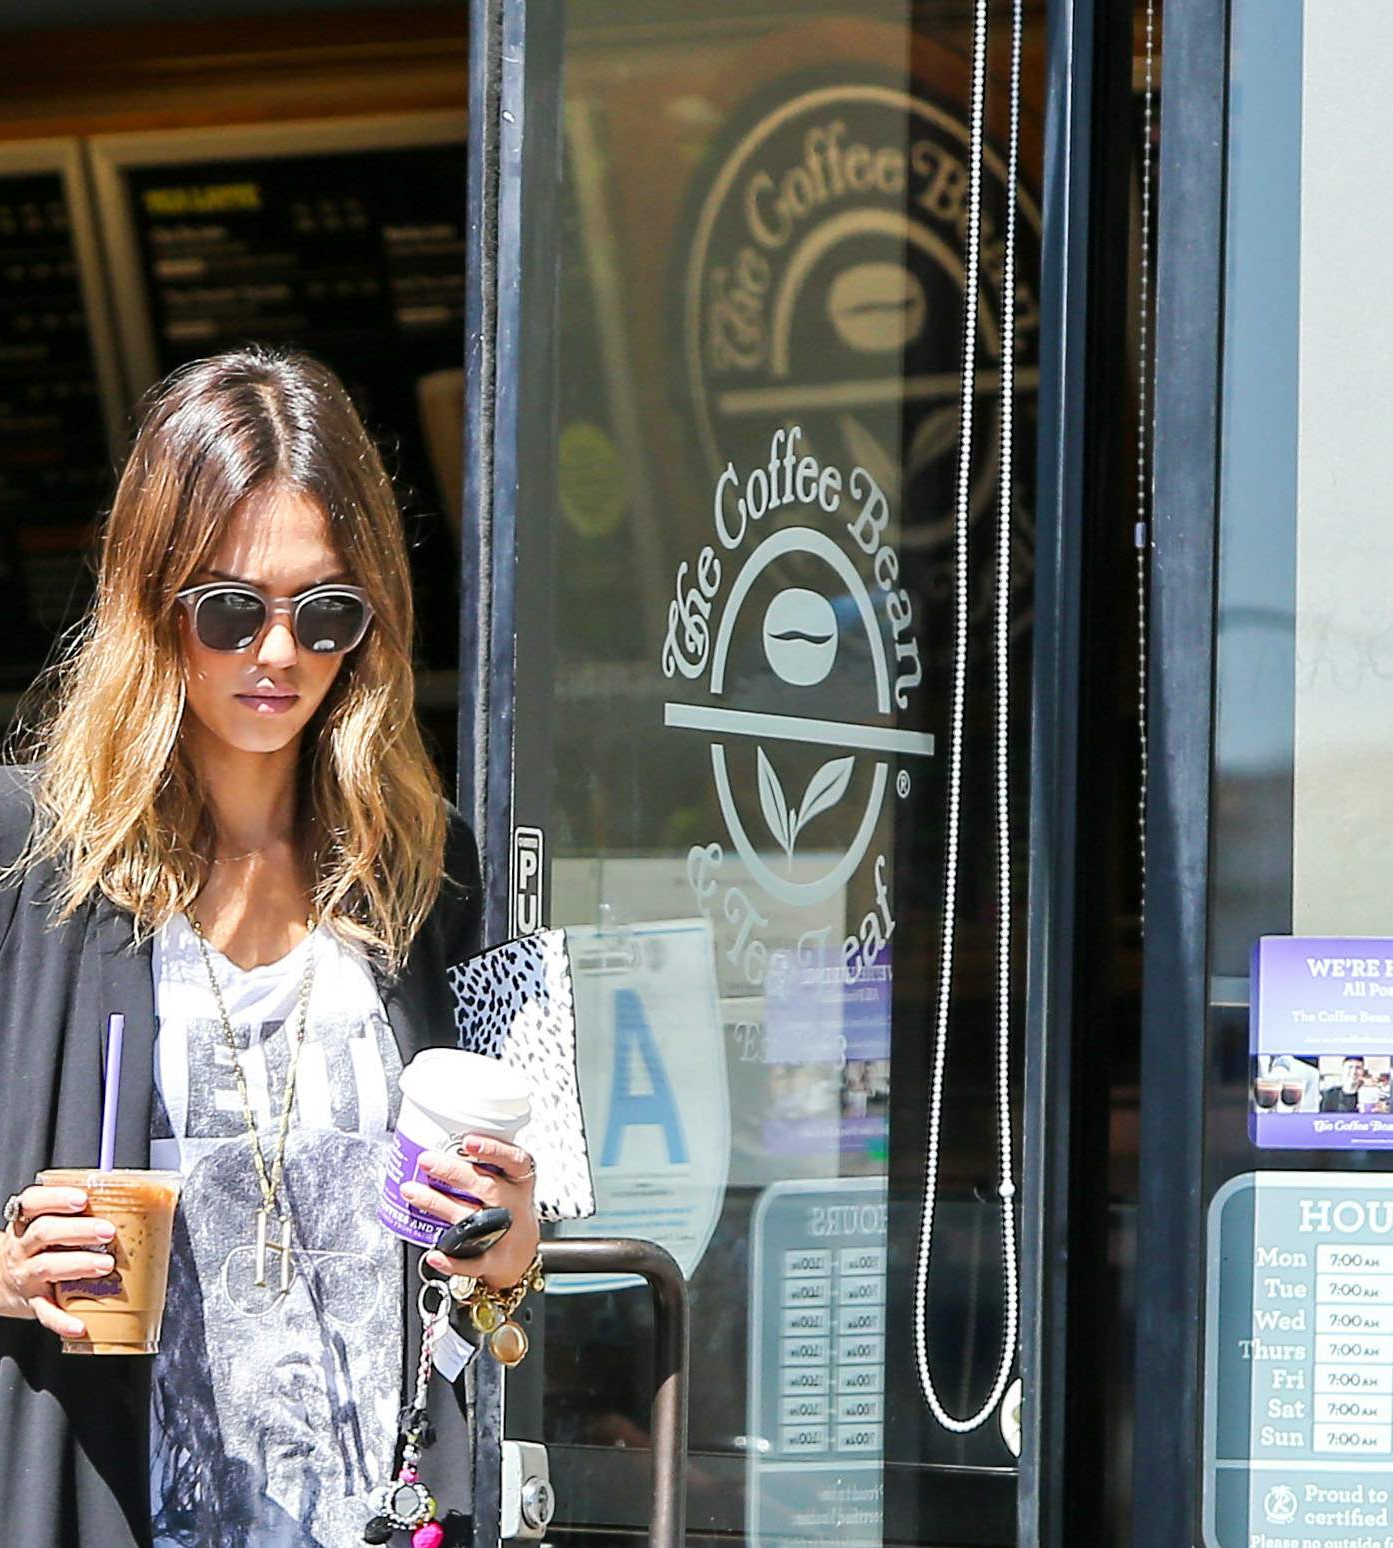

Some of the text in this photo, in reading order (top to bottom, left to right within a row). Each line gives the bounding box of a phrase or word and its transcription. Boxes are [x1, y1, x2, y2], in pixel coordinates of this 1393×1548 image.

[662, 425, 923, 710] The Coffee Bean
[1306, 957, 1381, 978] WE'RE
[1342, 981, 1366, 997] All
[599, 988, 691, 1167] A
[1255, 1246, 1308, 1268] Mon
[1263, 1277, 1308, 1298] Tue
[1253, 1308, 1306, 1331] Wed
[1238, 1338, 1306, 1361] Thurs
[1271, 1368, 1305, 1390] Fri
[1267, 1398, 1305, 1419] Sat
[1260, 1425, 1304, 1447] Sun
[1304, 1484, 1389, 1504] Proud to
[1304, 1507, 1389, 1527] certified
